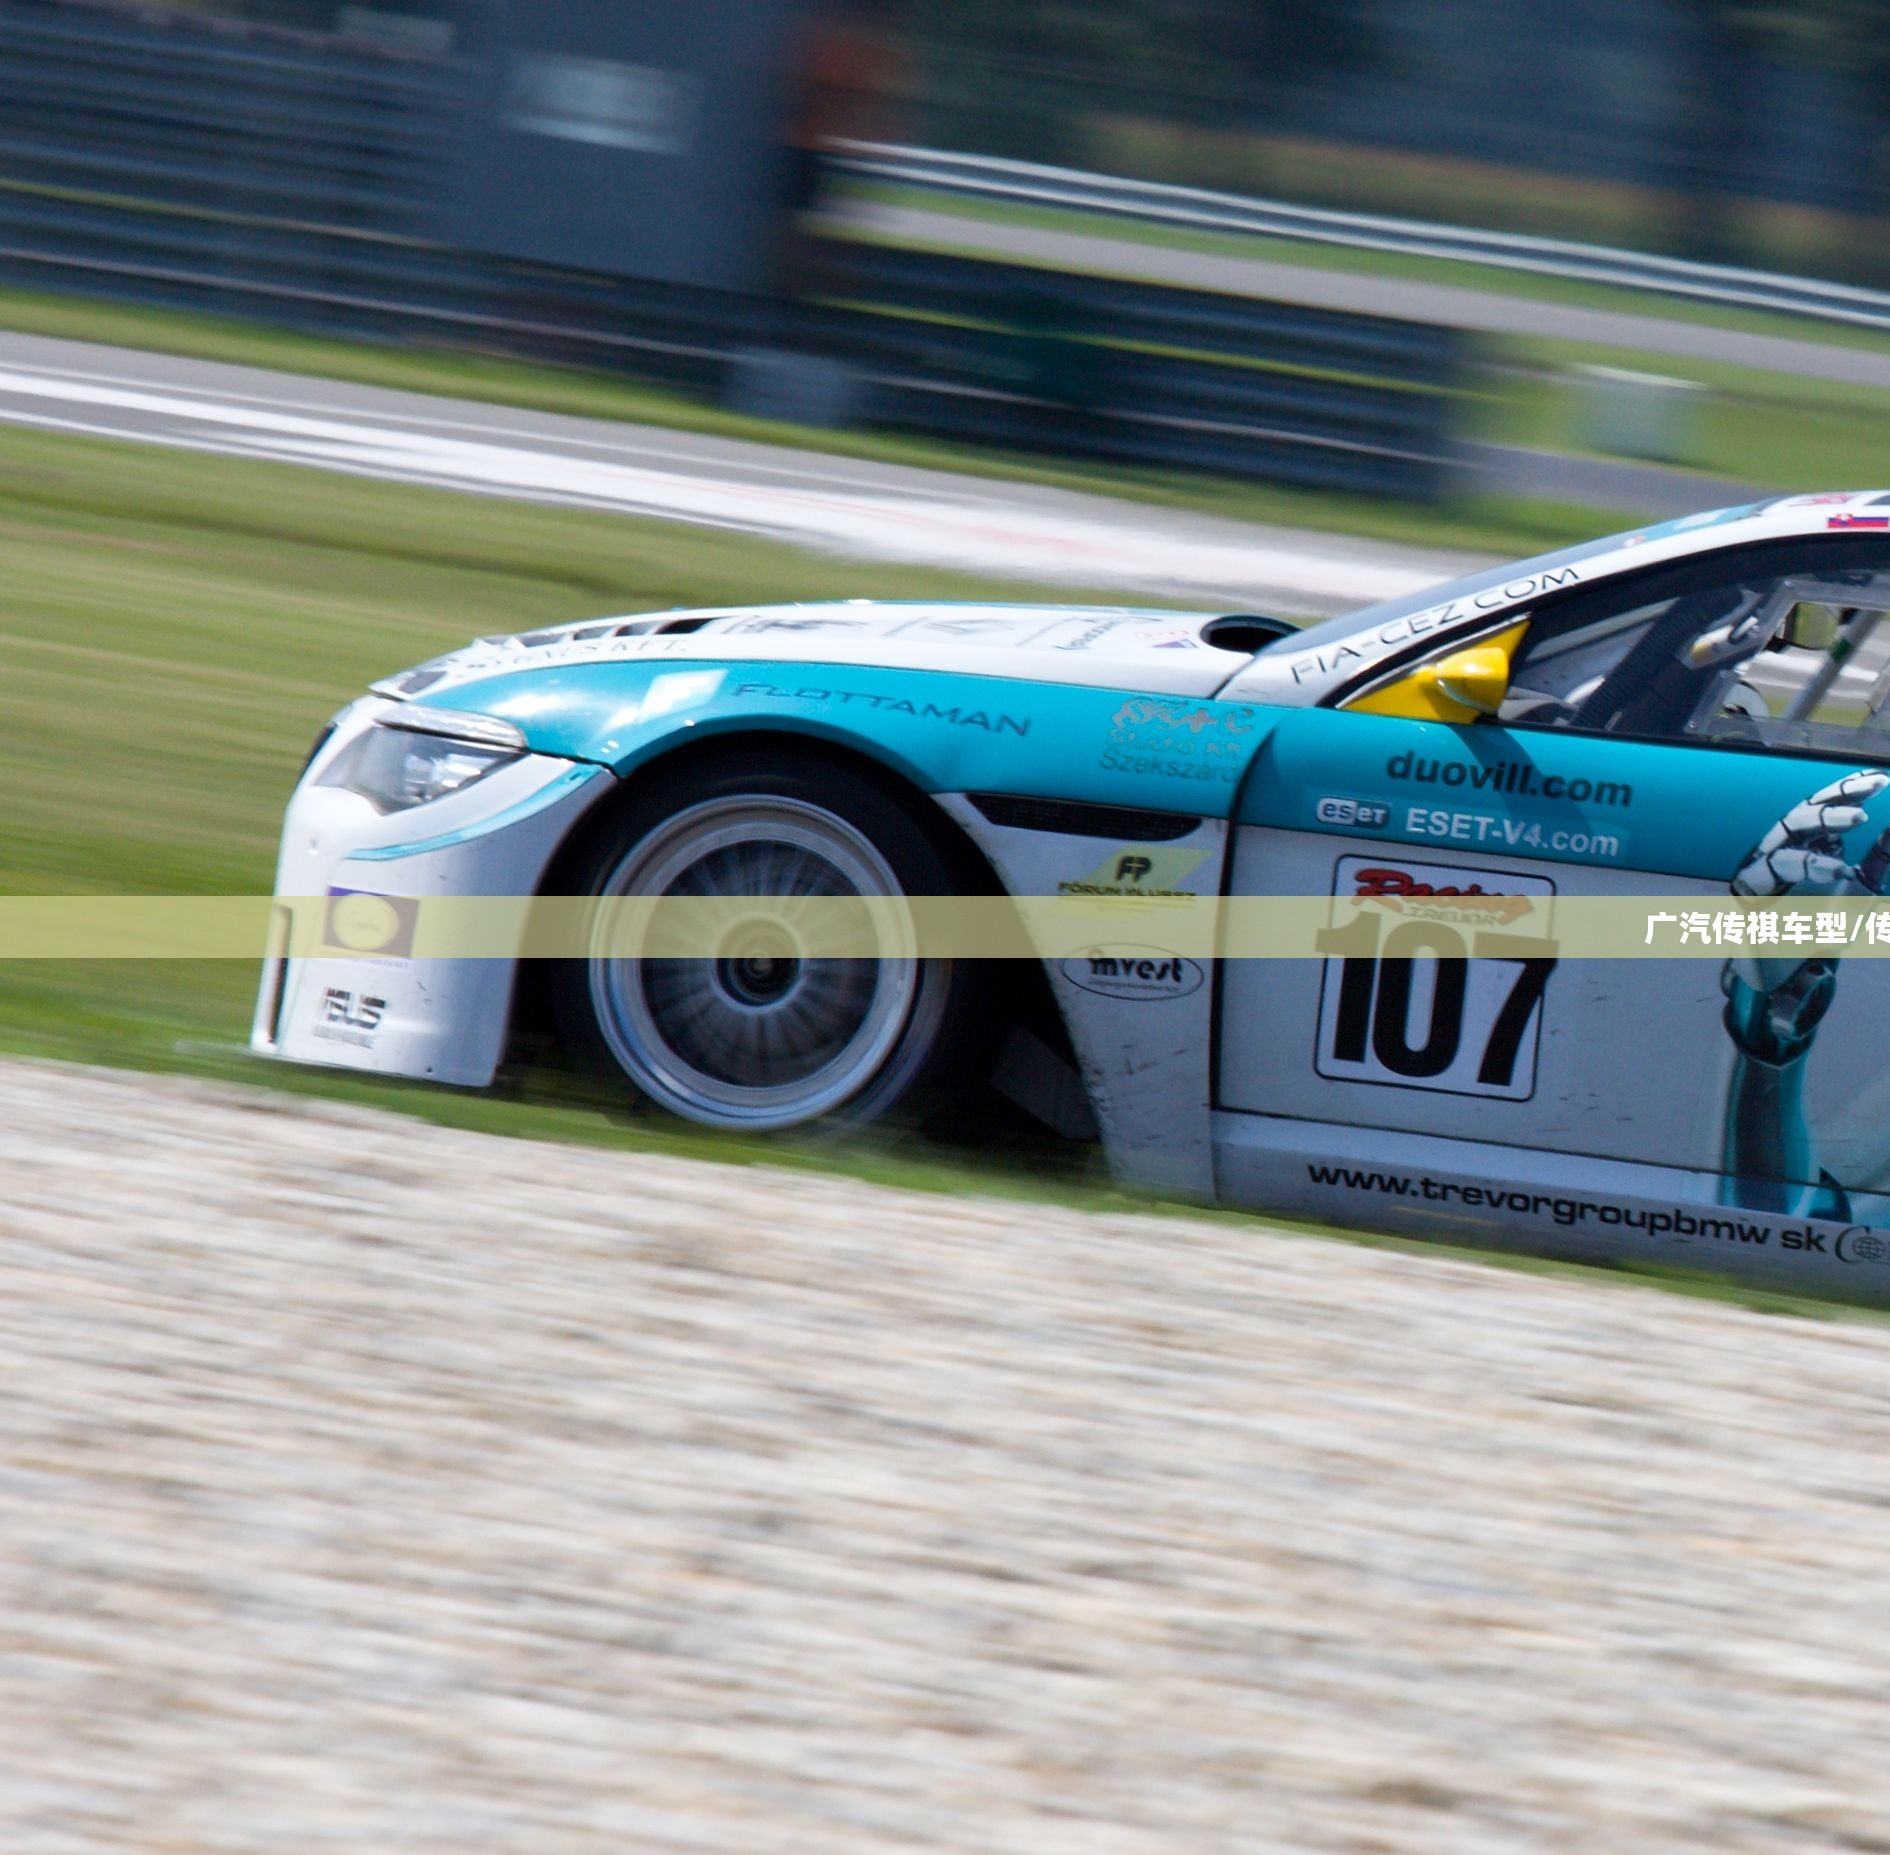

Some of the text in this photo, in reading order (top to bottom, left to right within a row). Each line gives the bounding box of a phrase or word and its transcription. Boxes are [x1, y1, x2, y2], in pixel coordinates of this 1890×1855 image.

[1386, 750, 1633, 807] duovill.com
[1406, 808, 1620, 857] ESET-V4.com
[1315, 910, 1560, 1087] 107
